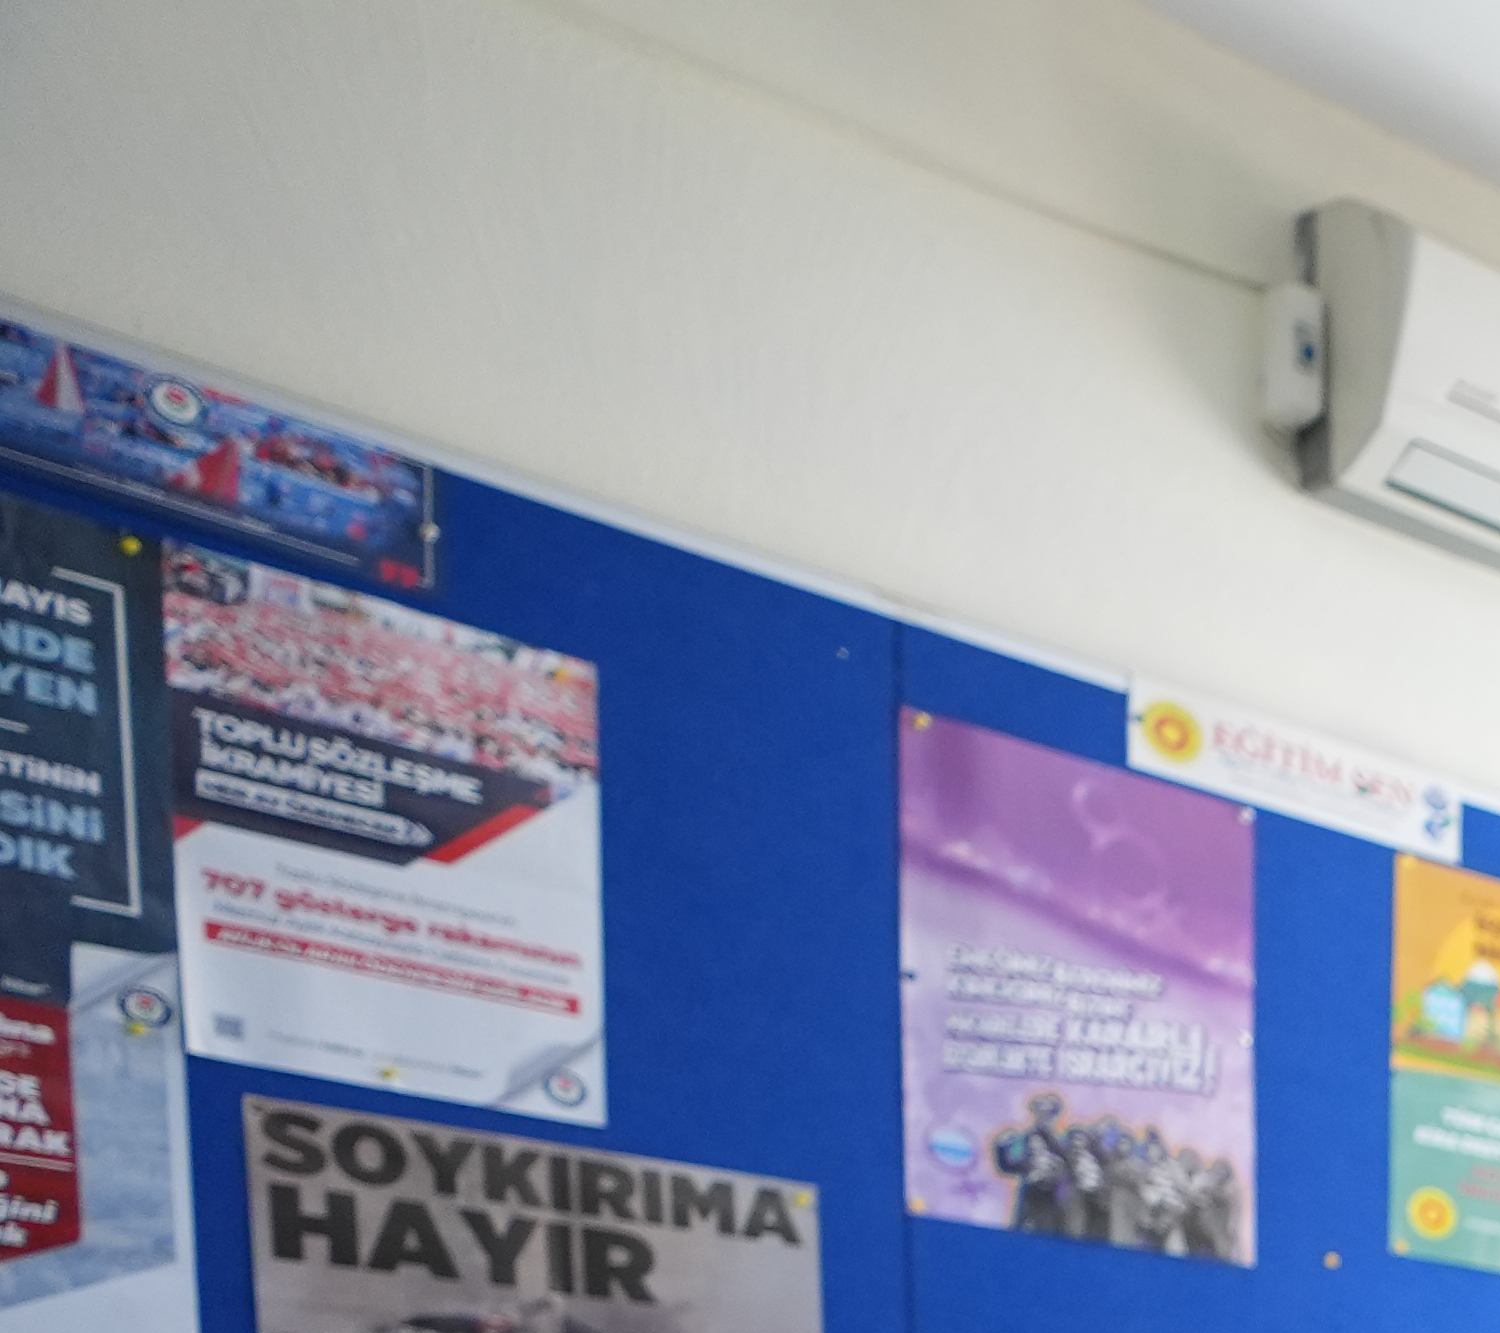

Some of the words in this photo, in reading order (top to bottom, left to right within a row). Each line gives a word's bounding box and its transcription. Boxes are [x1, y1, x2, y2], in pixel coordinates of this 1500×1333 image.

[0, 578, 91, 627] AYIS
[193, 707, 307, 758] TOPLU
[309, 736, 484, 805] SÖZLEŞME
[262, 1109, 803, 1248] SOYKIRIMA
[267, 1182, 661, 1306] HAYIR
